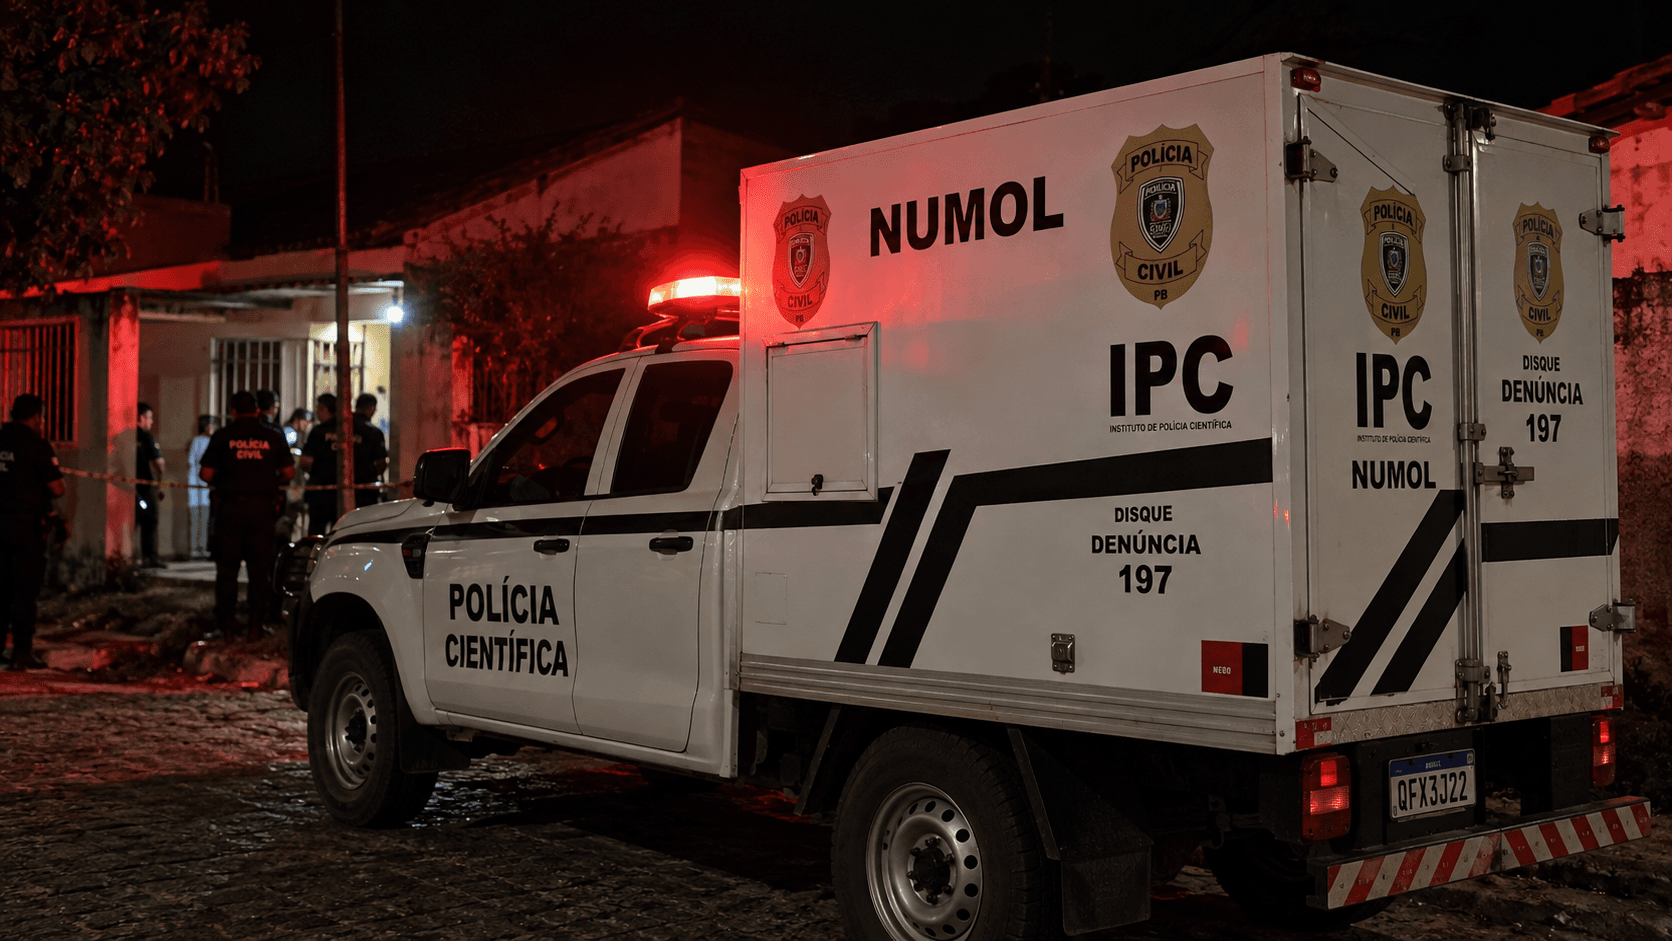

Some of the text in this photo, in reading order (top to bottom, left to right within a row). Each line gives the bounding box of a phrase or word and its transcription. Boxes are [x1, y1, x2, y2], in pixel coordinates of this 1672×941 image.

[1131, 143, 1192, 173] POLÍCIA
[784, 208, 819, 229] POLÍCIA
[870, 176, 1064, 257] NUMOL
[1374, 202, 1413, 227] POLÍCIA
[1522, 216, 1554, 238] POLÍCIA
[1137, 260, 1184, 281] CIVIL
[787, 293, 813, 309] CIVIL
[1154, 289, 1168, 301] PB
[1381, 302, 1410, 320] CIVIL
[1528, 306, 1551, 322] CIVIL
[1391, 327, 1401, 337] PB
[1522, 355, 1561, 372] DISQUE
[1110, 335, 1234, 417] IPC
[1356, 352, 1433, 430] IPC
[1501, 375, 1584, 405] DENÚNCIA
[1109, 419, 1232, 433] INSTITUTO DE POLÍCIA CIENTÍFICA
[1526, 413, 1562, 443] 197
[228, 437, 270, 450] POLÍCIA
[1382, 435, 1389, 443] DE
[236, 449, 263, 460] CIVIL
[1352, 460, 1436, 489] NUMOL
[1114, 505, 1173, 523] DISQUE
[1091, 529, 1201, 555] DENÚNCIA
[1118, 564, 1173, 594] 197
[450, 575, 560, 625] POLÍCIA
[445, 629, 569, 677] CIENTÍFICA
[1398, 771, 1468, 811] QFX3J22
